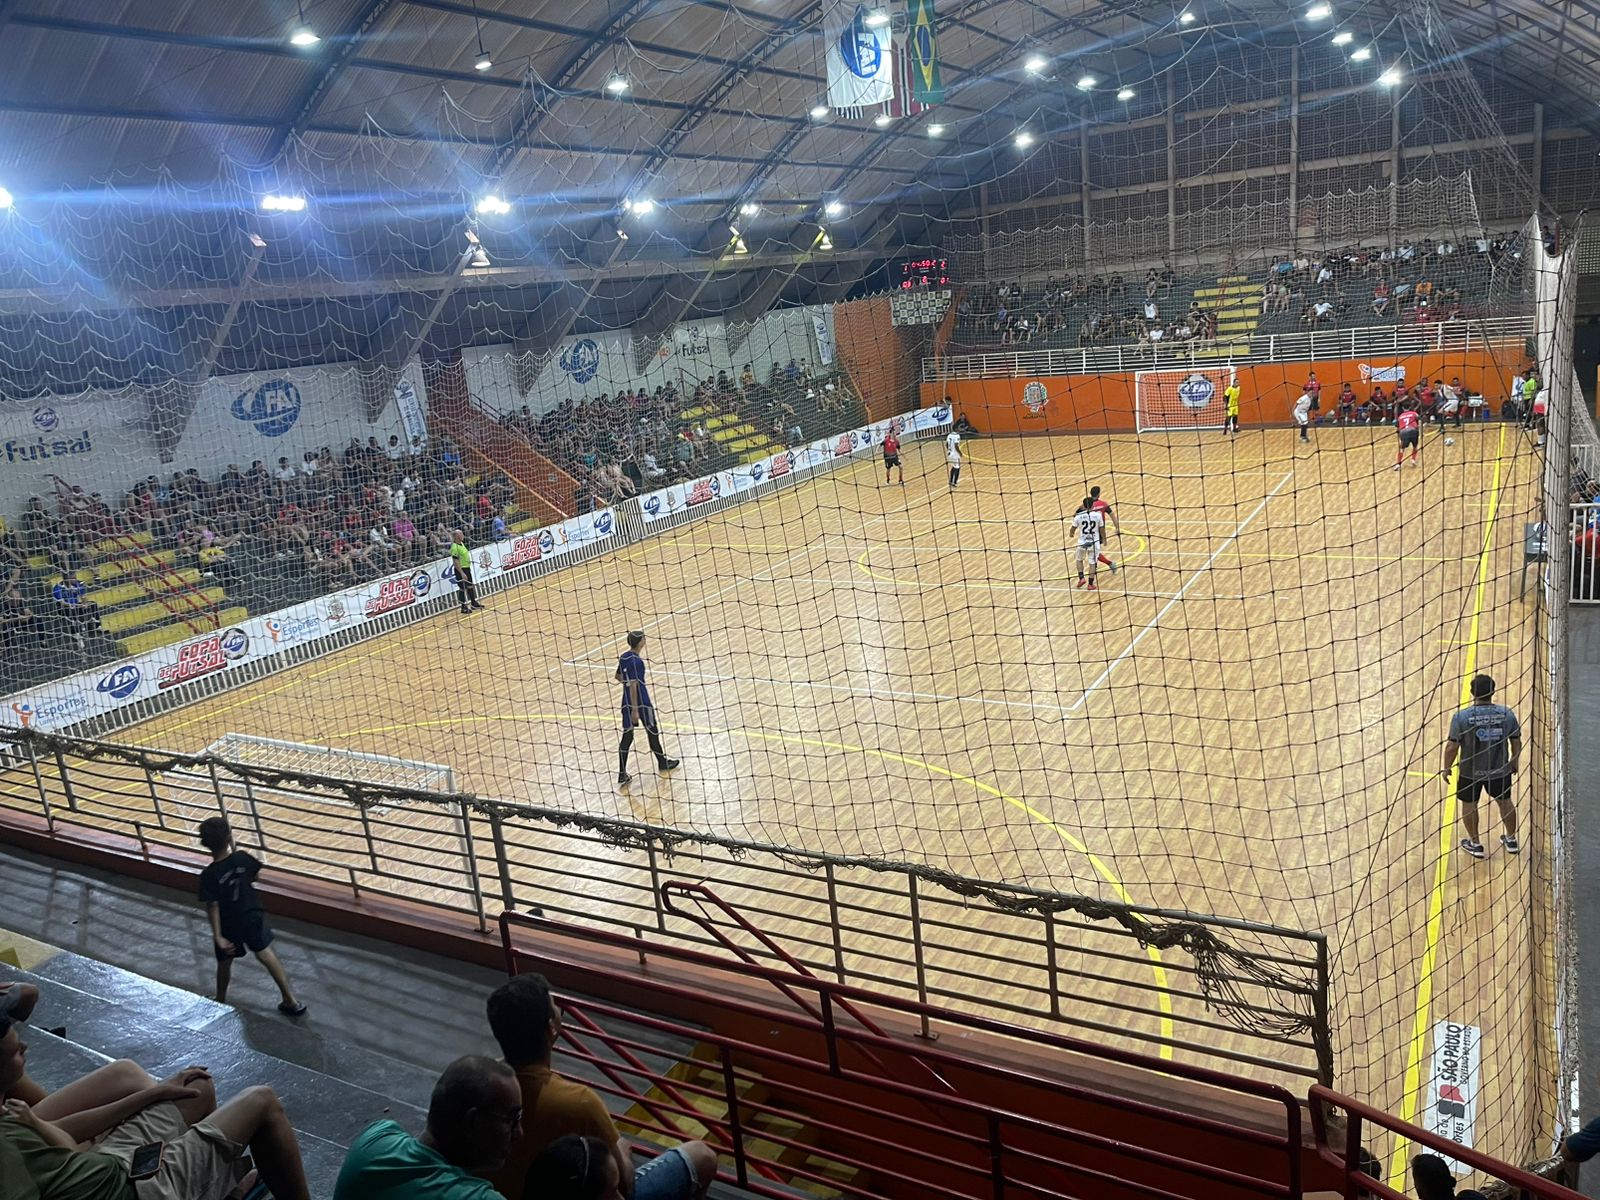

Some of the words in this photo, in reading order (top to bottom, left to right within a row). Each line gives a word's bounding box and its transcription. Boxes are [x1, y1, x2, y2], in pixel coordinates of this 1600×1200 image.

[1081, 520, 1096, 535] 22
[381, 576, 410, 596] COPA
[179, 636, 219, 662] COPA
[171, 650, 226, 680] FUTSAL
[36, 697, 86, 719] Esportes
[1444, 1024, 1462, 1058] PAULO
[1437, 1059, 1458, 1083] SÃO
